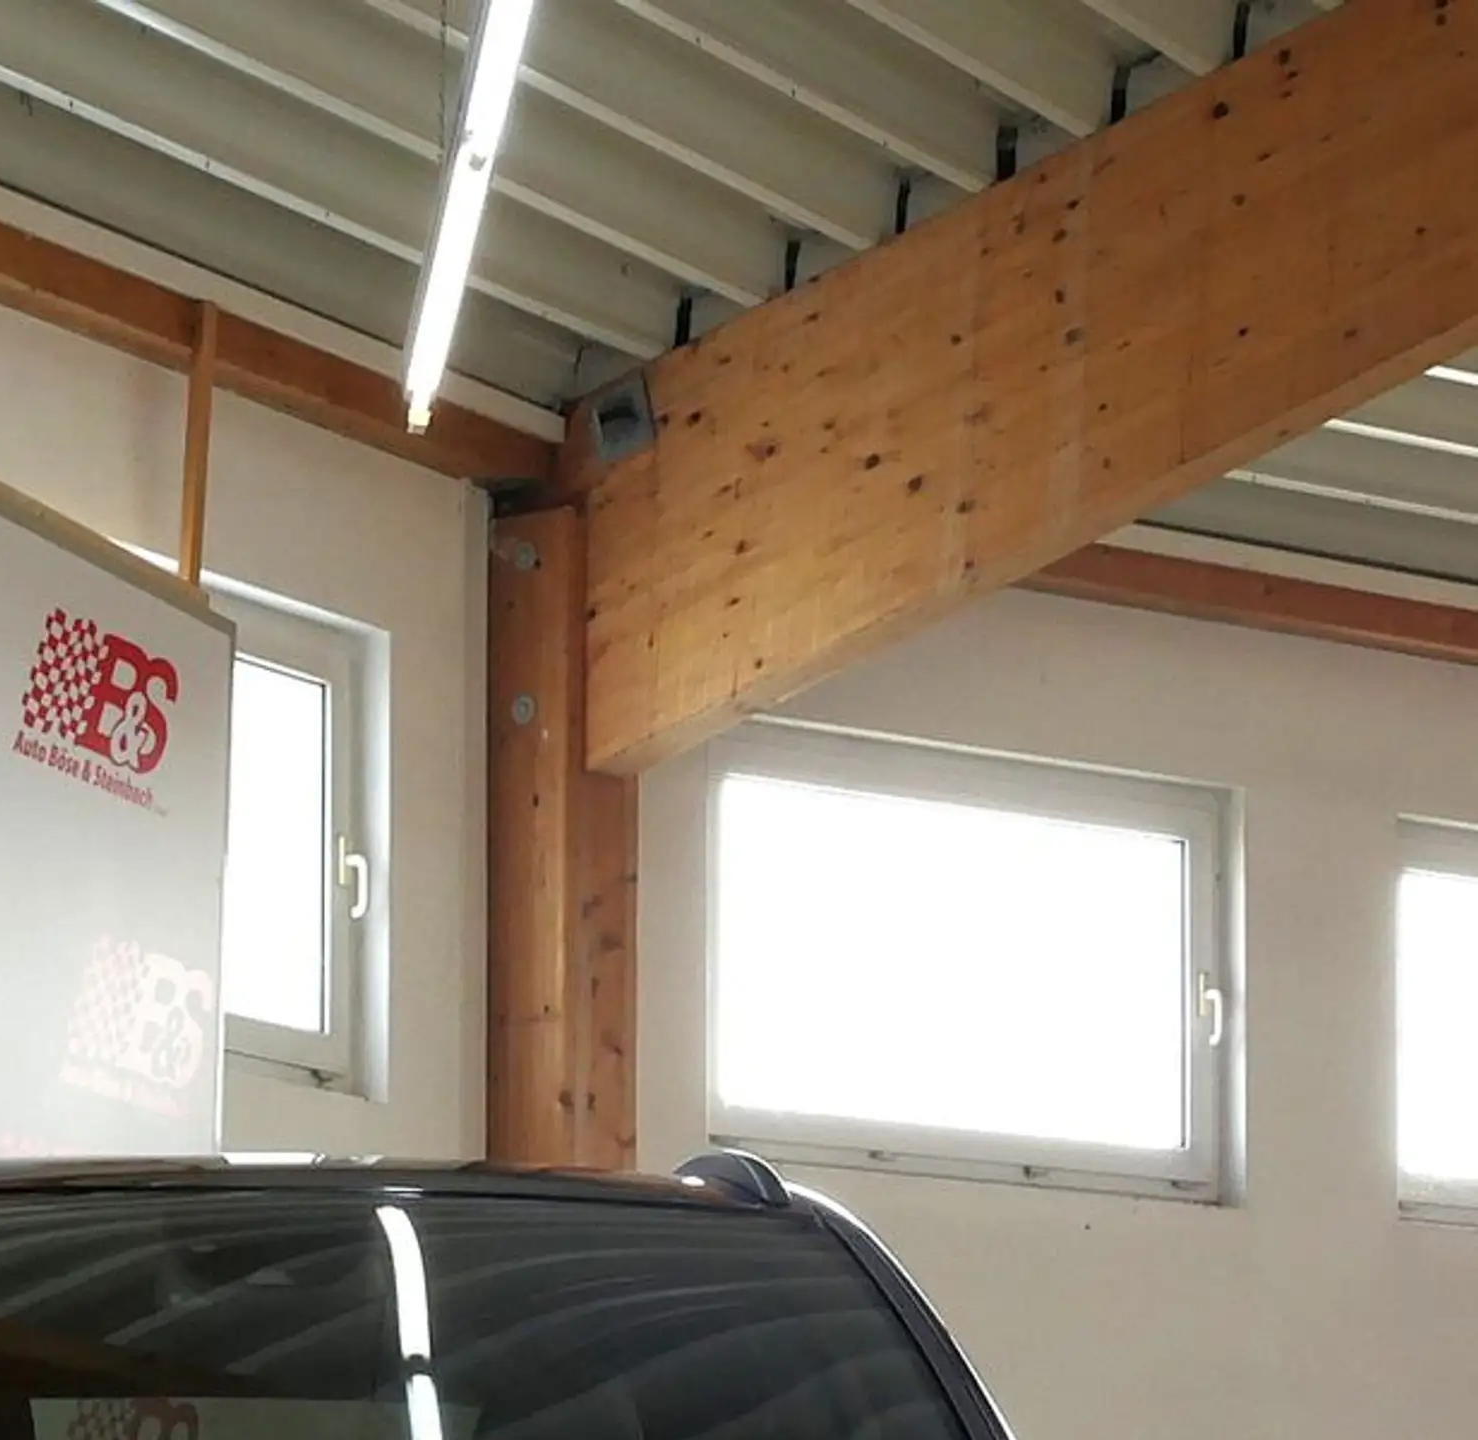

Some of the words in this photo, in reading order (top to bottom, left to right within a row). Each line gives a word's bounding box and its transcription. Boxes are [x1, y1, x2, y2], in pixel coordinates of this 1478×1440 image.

[74, 633, 179, 774] B&S
[12, 730, 47, 763] Auto
[48, 745, 80, 779] Böse
[82, 760, 91, 783] &
[93, 764, 153, 806] Steinbach
